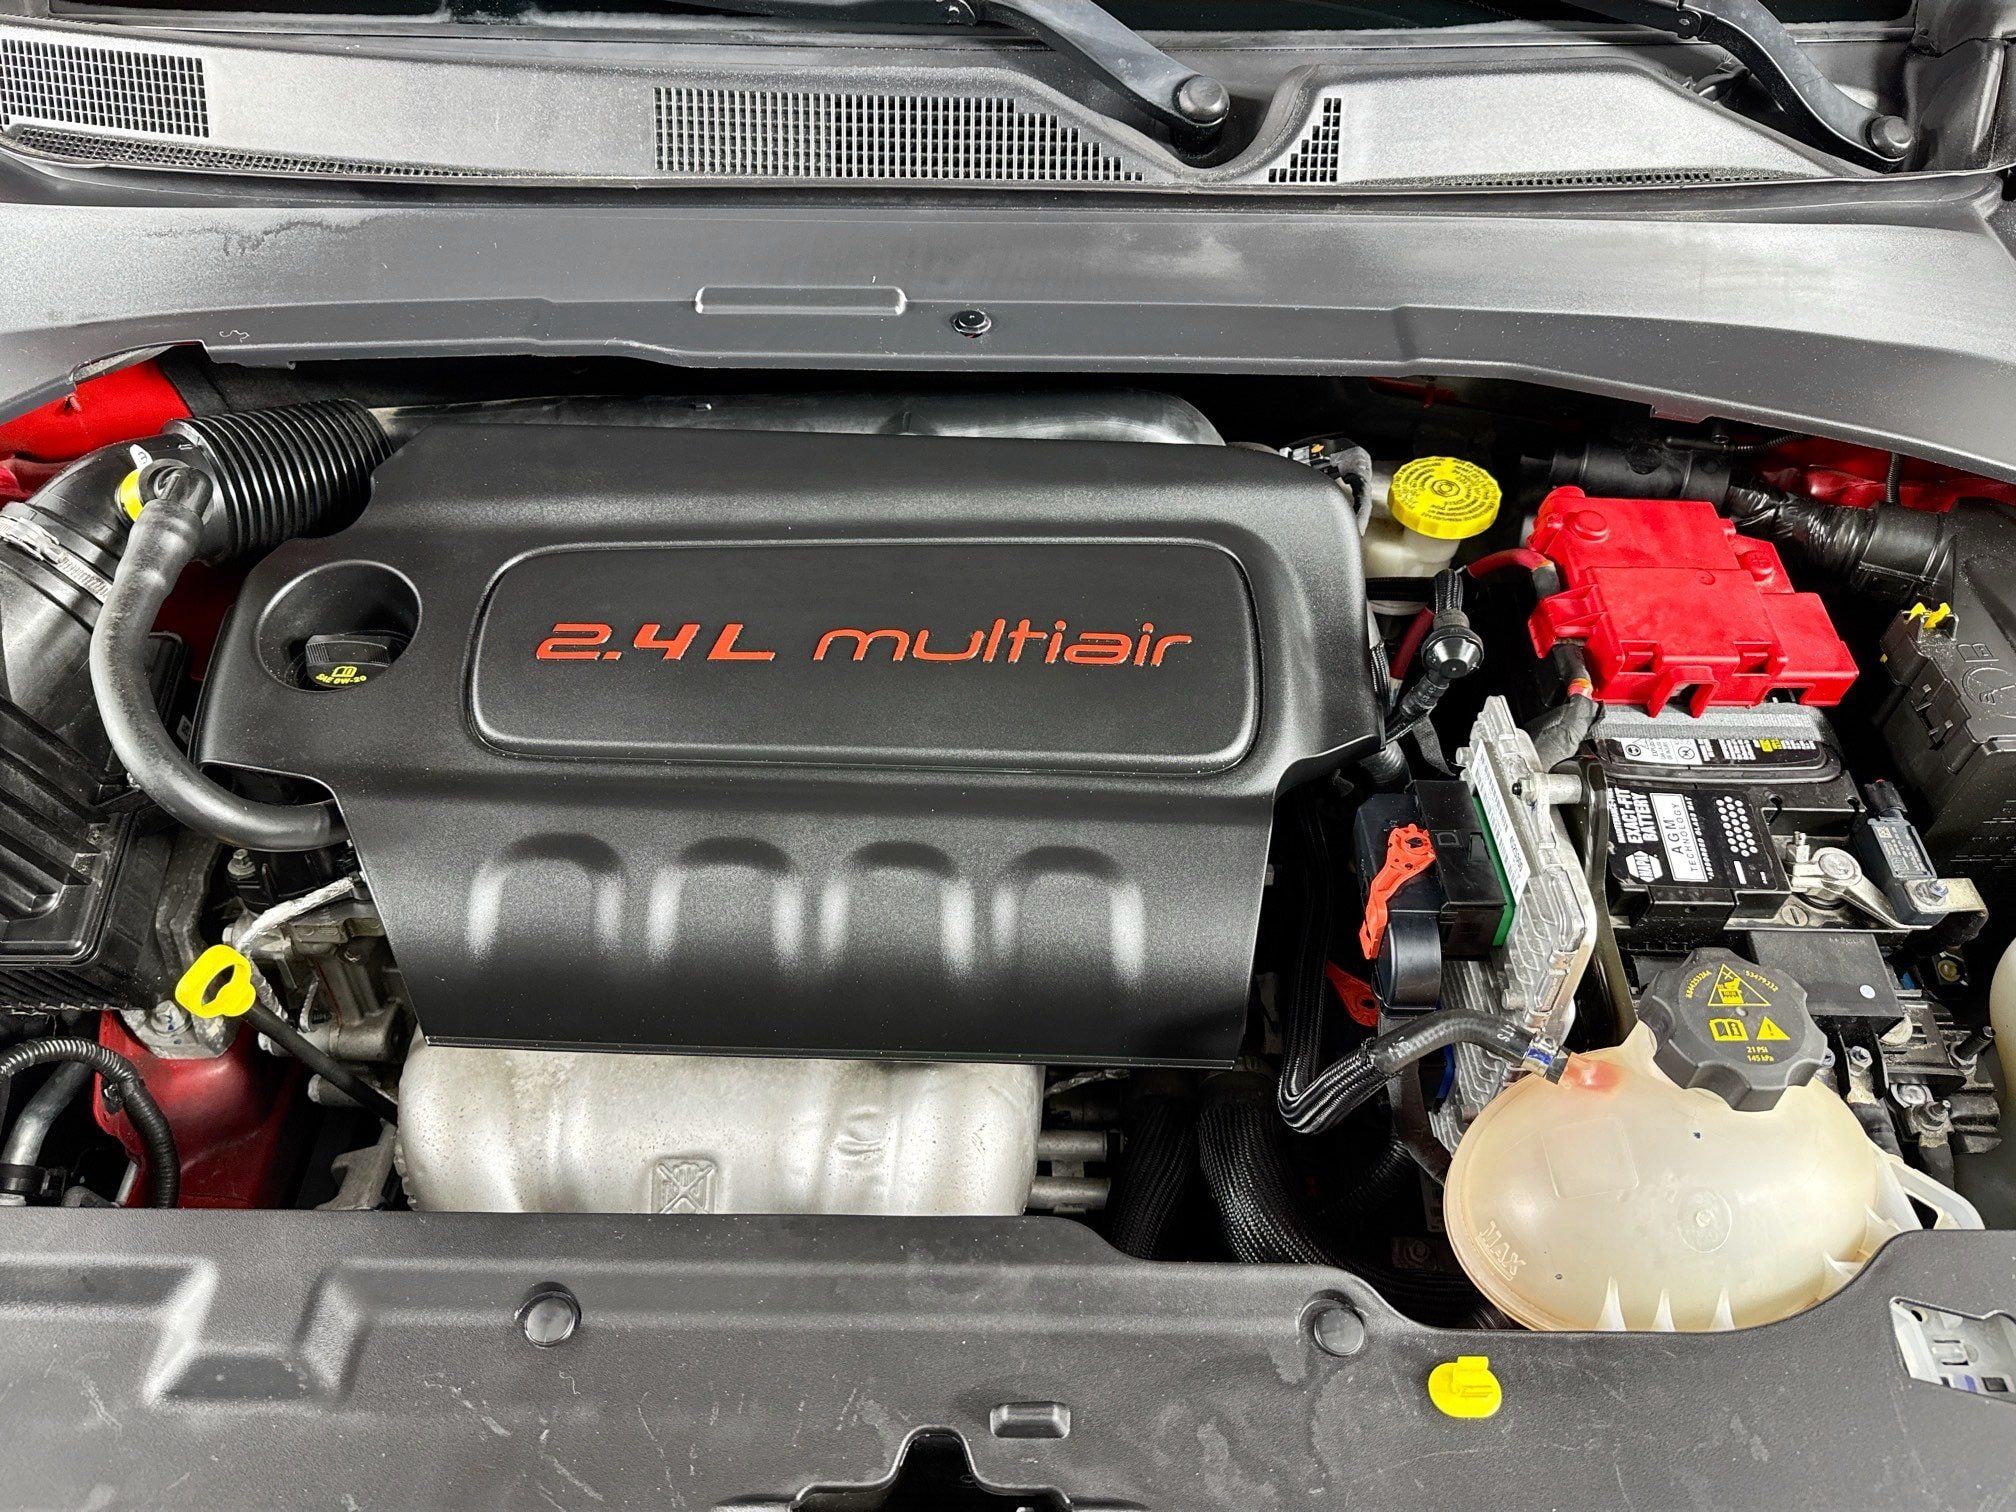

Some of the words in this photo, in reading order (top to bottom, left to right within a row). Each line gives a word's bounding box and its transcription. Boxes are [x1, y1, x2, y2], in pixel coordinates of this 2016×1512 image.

[812, 618, 1193, 667] multiair
[1615, 788, 1644, 844] EXACT-FIT
[1631, 792, 1659, 842] BATTERY
[1672, 802, 1699, 872] TECHNOLOGY
[1632, 852, 1655, 880] NAPA
[1746, 1046, 1756, 1054] 21
[1761, 1055, 1774, 1063] kPa
[1478, 1220, 1527, 1277] MAX
